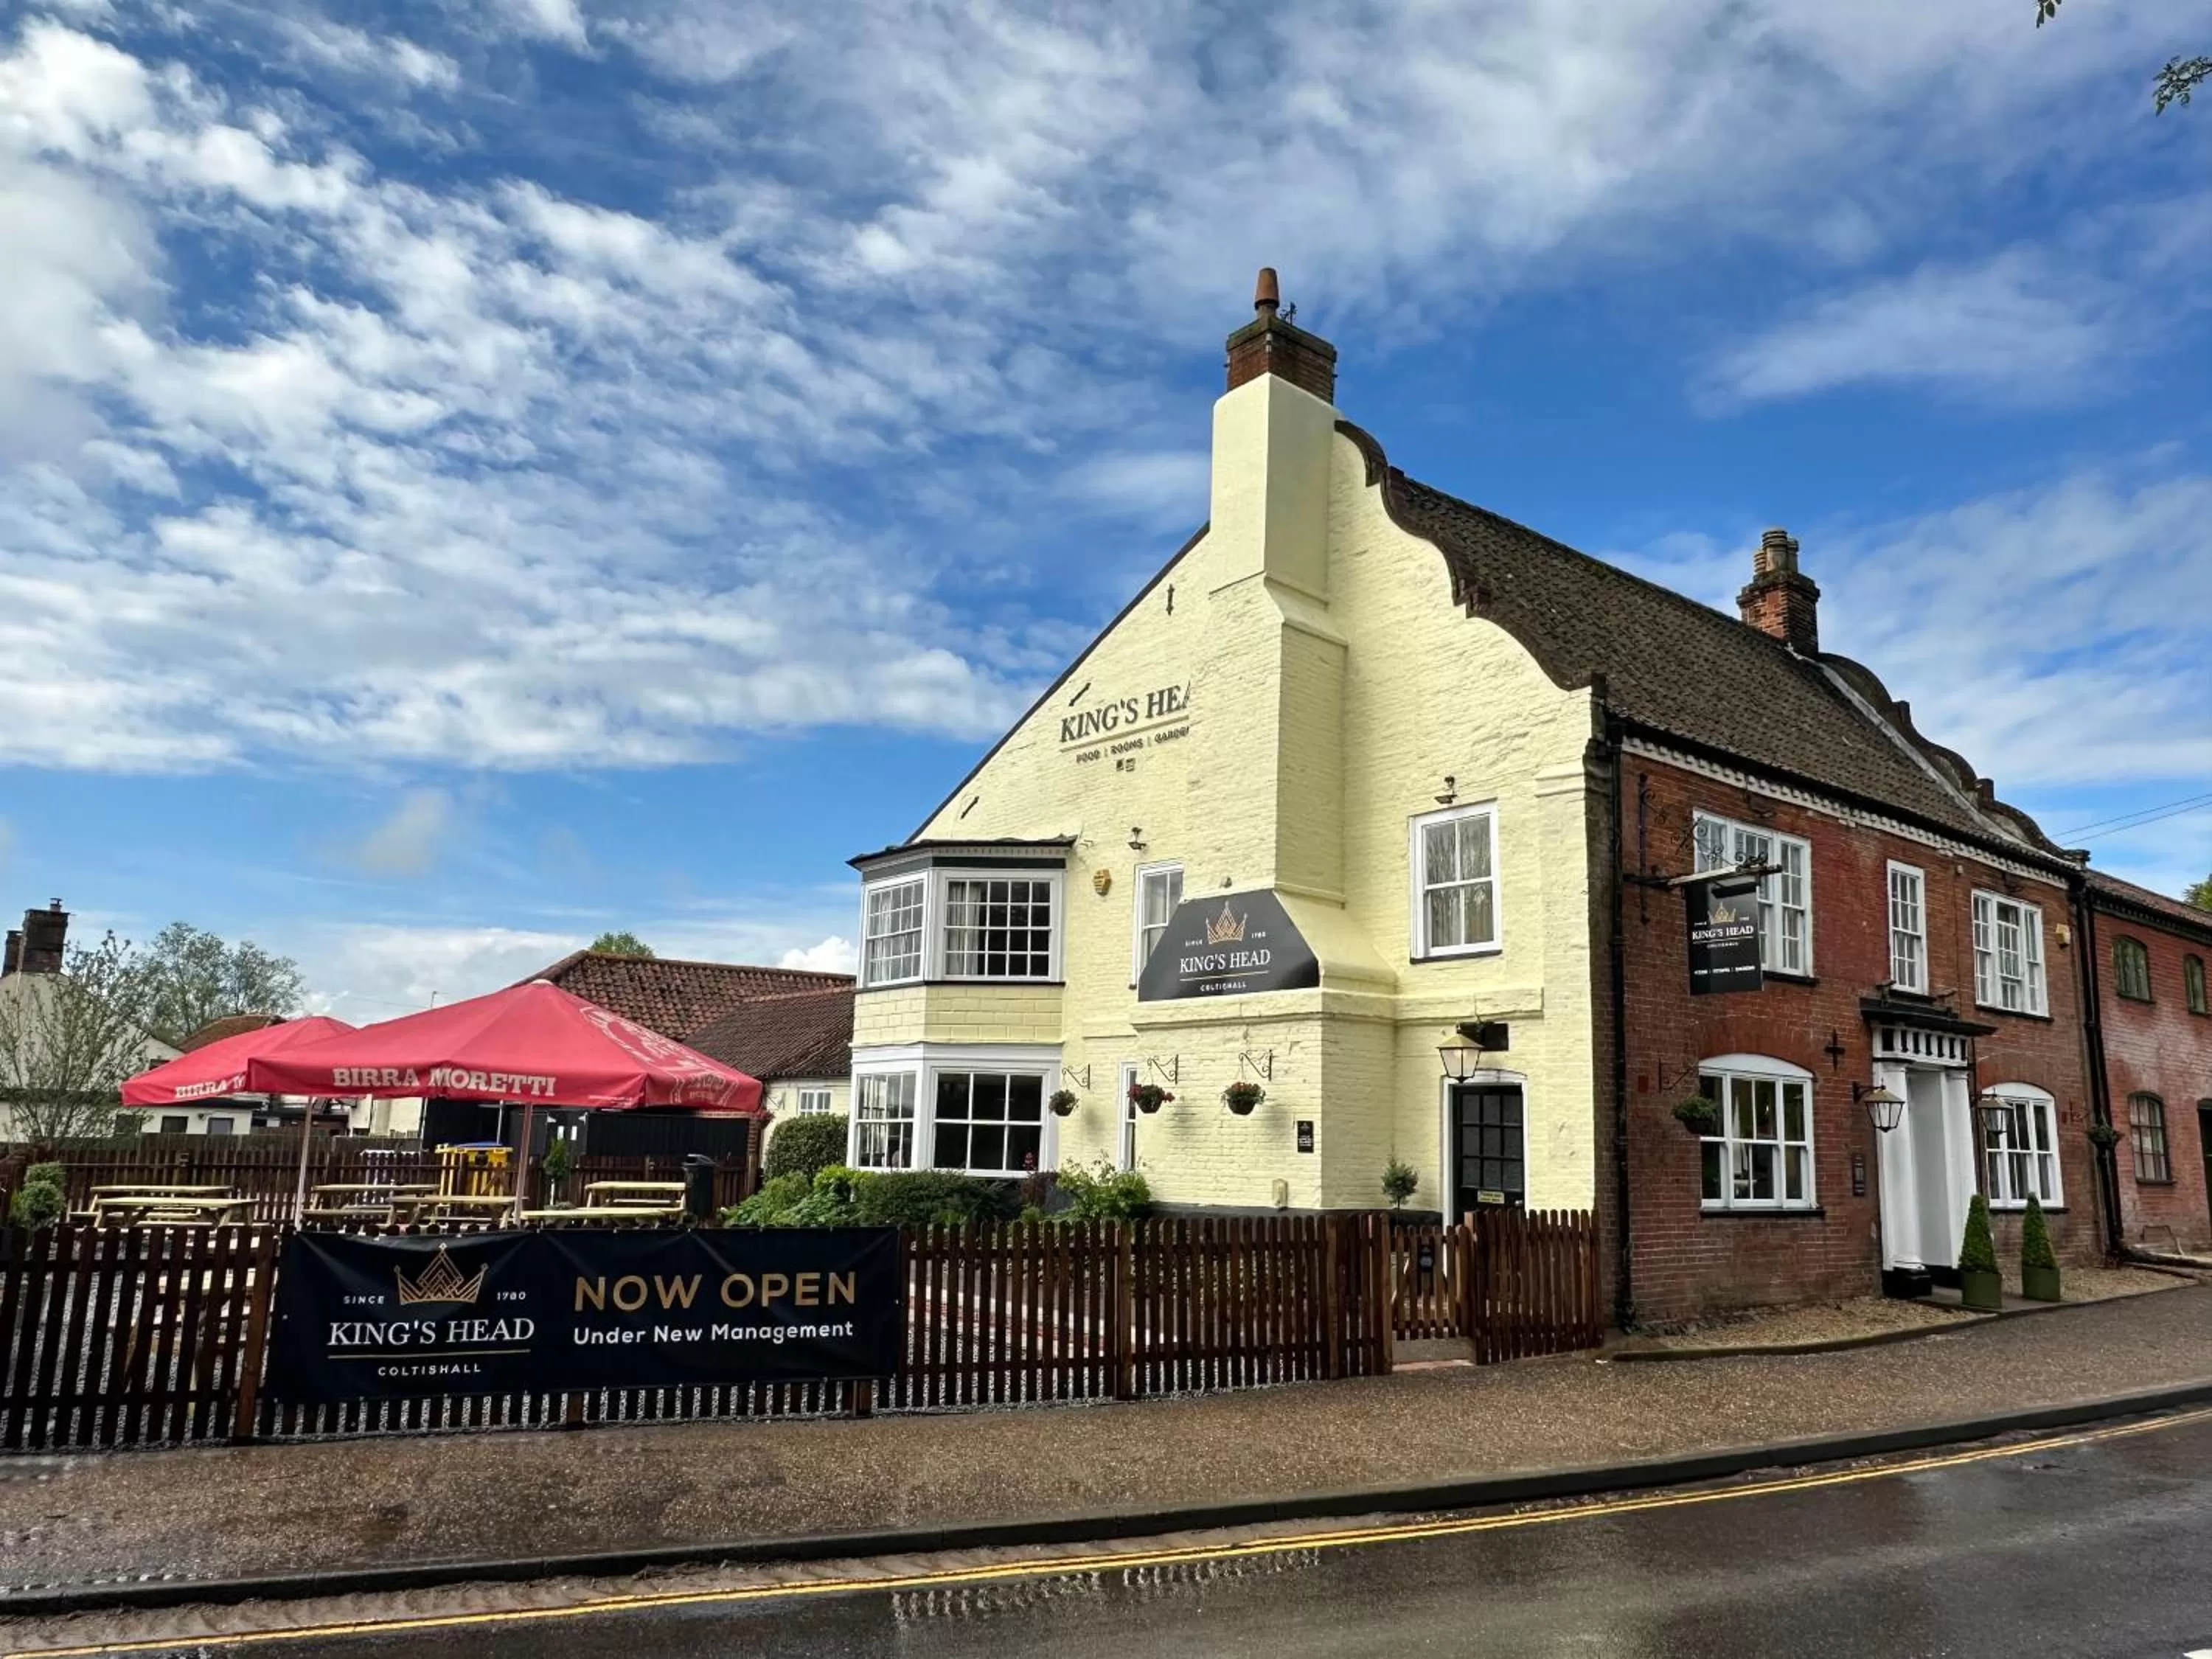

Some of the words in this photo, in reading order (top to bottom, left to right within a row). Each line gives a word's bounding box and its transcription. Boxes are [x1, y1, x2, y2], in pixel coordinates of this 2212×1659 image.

[1059, 698, 1138, 742] KING'S
[1110, 738, 1144, 754] ROOMS
[1692, 928, 1723, 940] KING'S
[1726, 925, 1754, 936] HEAD
[1180, 954, 1226, 973] KING'S
[1229, 949, 1270, 968] HEAD
[175, 1080, 227, 1098] BIRRA
[333, 1067, 420, 1087] BIRRA
[428, 1067, 557, 1096] MORETTI
[343, 1295, 385, 1304] SINCE
[496, 1291, 526, 1300] 1780
[574, 1273, 703, 1312] NOW
[720, 1271, 857, 1309] OPEN
[327, 1319, 437, 1346] KING'S
[445, 1318, 535, 1343] HEAD
[573, 1326, 646, 1345] Under
[653, 1325, 703, 1343] New
[710, 1321, 854, 1344] Management
[377, 1363, 482, 1377] COLTISHALL
